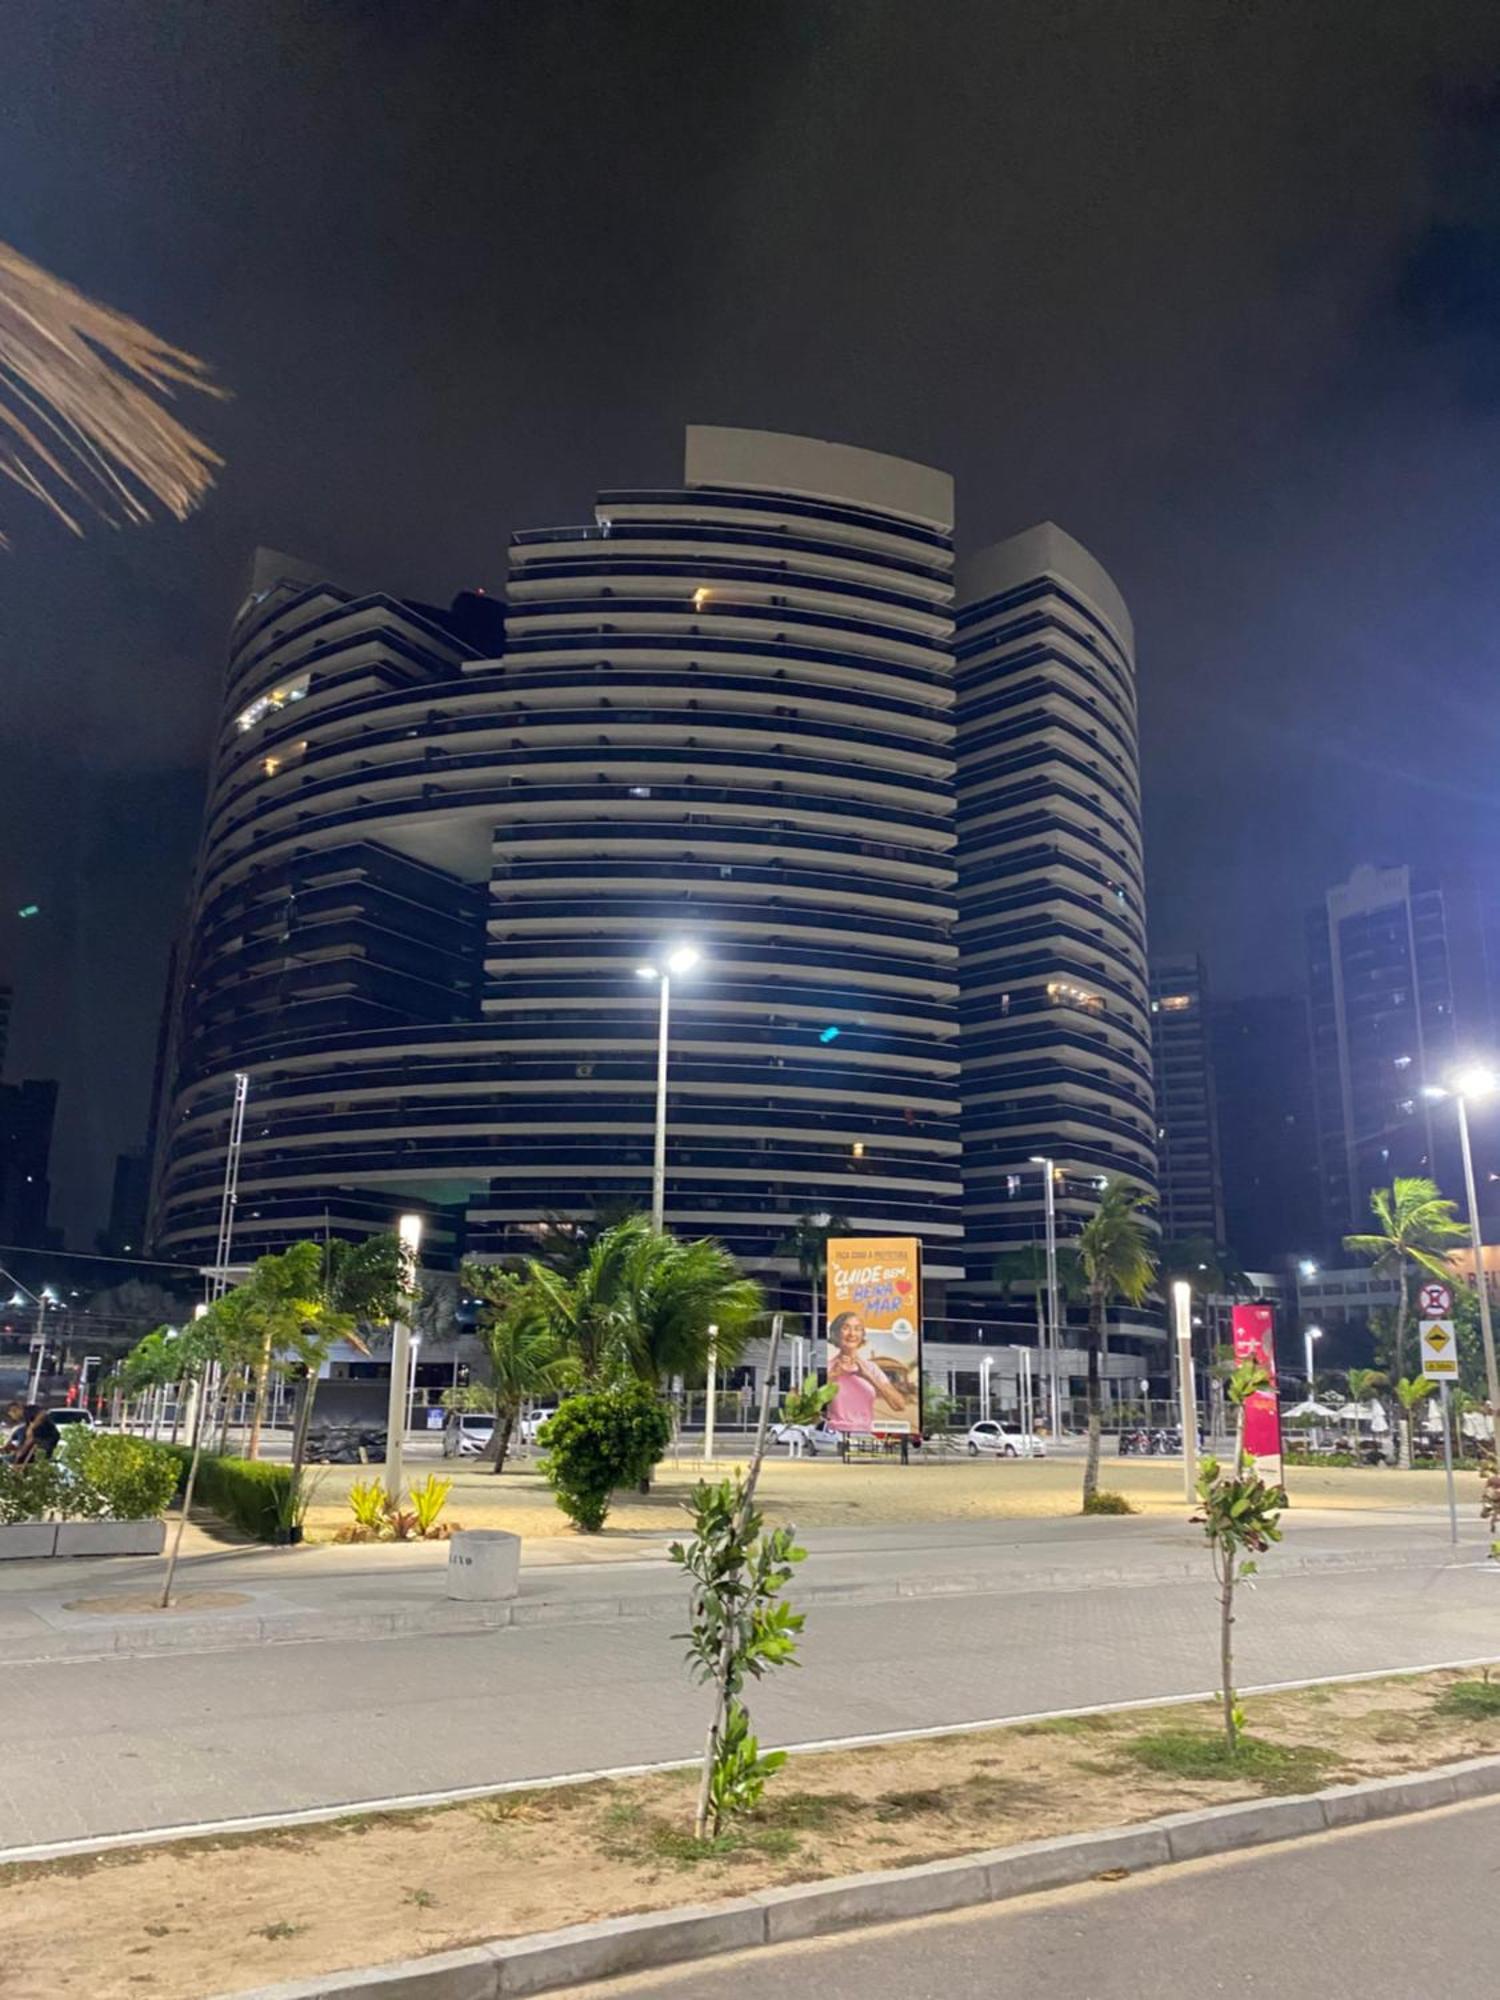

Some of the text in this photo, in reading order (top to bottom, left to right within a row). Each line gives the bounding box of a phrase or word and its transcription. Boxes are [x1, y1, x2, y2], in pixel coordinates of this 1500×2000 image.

[834, 1265, 906, 1287] CUIDE BEM
[853, 1282, 893, 1303] BEIRA
[866, 1296, 902, 1315] MAR
